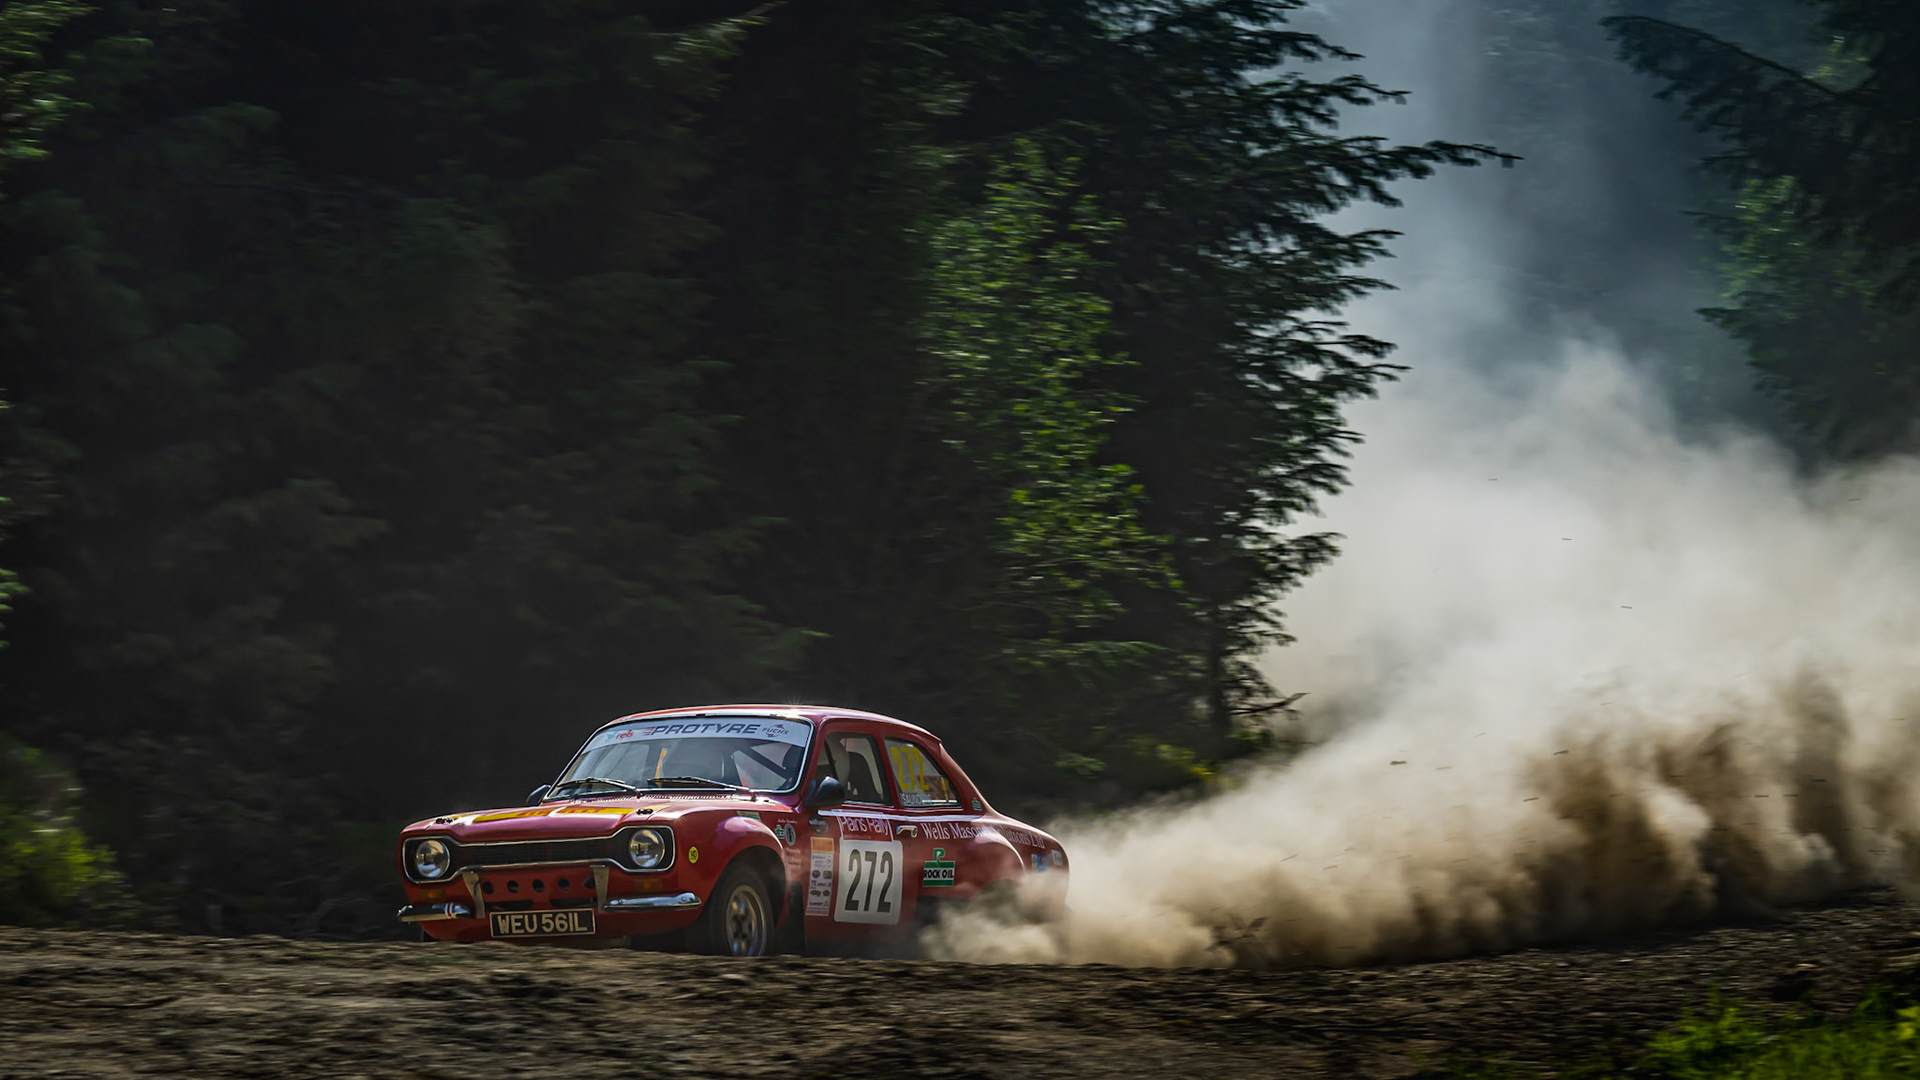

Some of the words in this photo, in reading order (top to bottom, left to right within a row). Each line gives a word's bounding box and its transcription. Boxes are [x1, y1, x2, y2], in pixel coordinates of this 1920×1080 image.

[650, 724, 761, 736] PROTYRE
[761, 727, 790, 735] FUCHS
[890, 746, 930, 790] 272
[920, 823, 951, 840] Wells
[1029, 831, 1046, 849] Ltd
[845, 849, 893, 913] 272
[924, 869, 940, 879] ROCK
[941, 869, 954, 878] OIL
[497, 914, 537, 934] WEU
[541, 912, 588, 933] 561L
